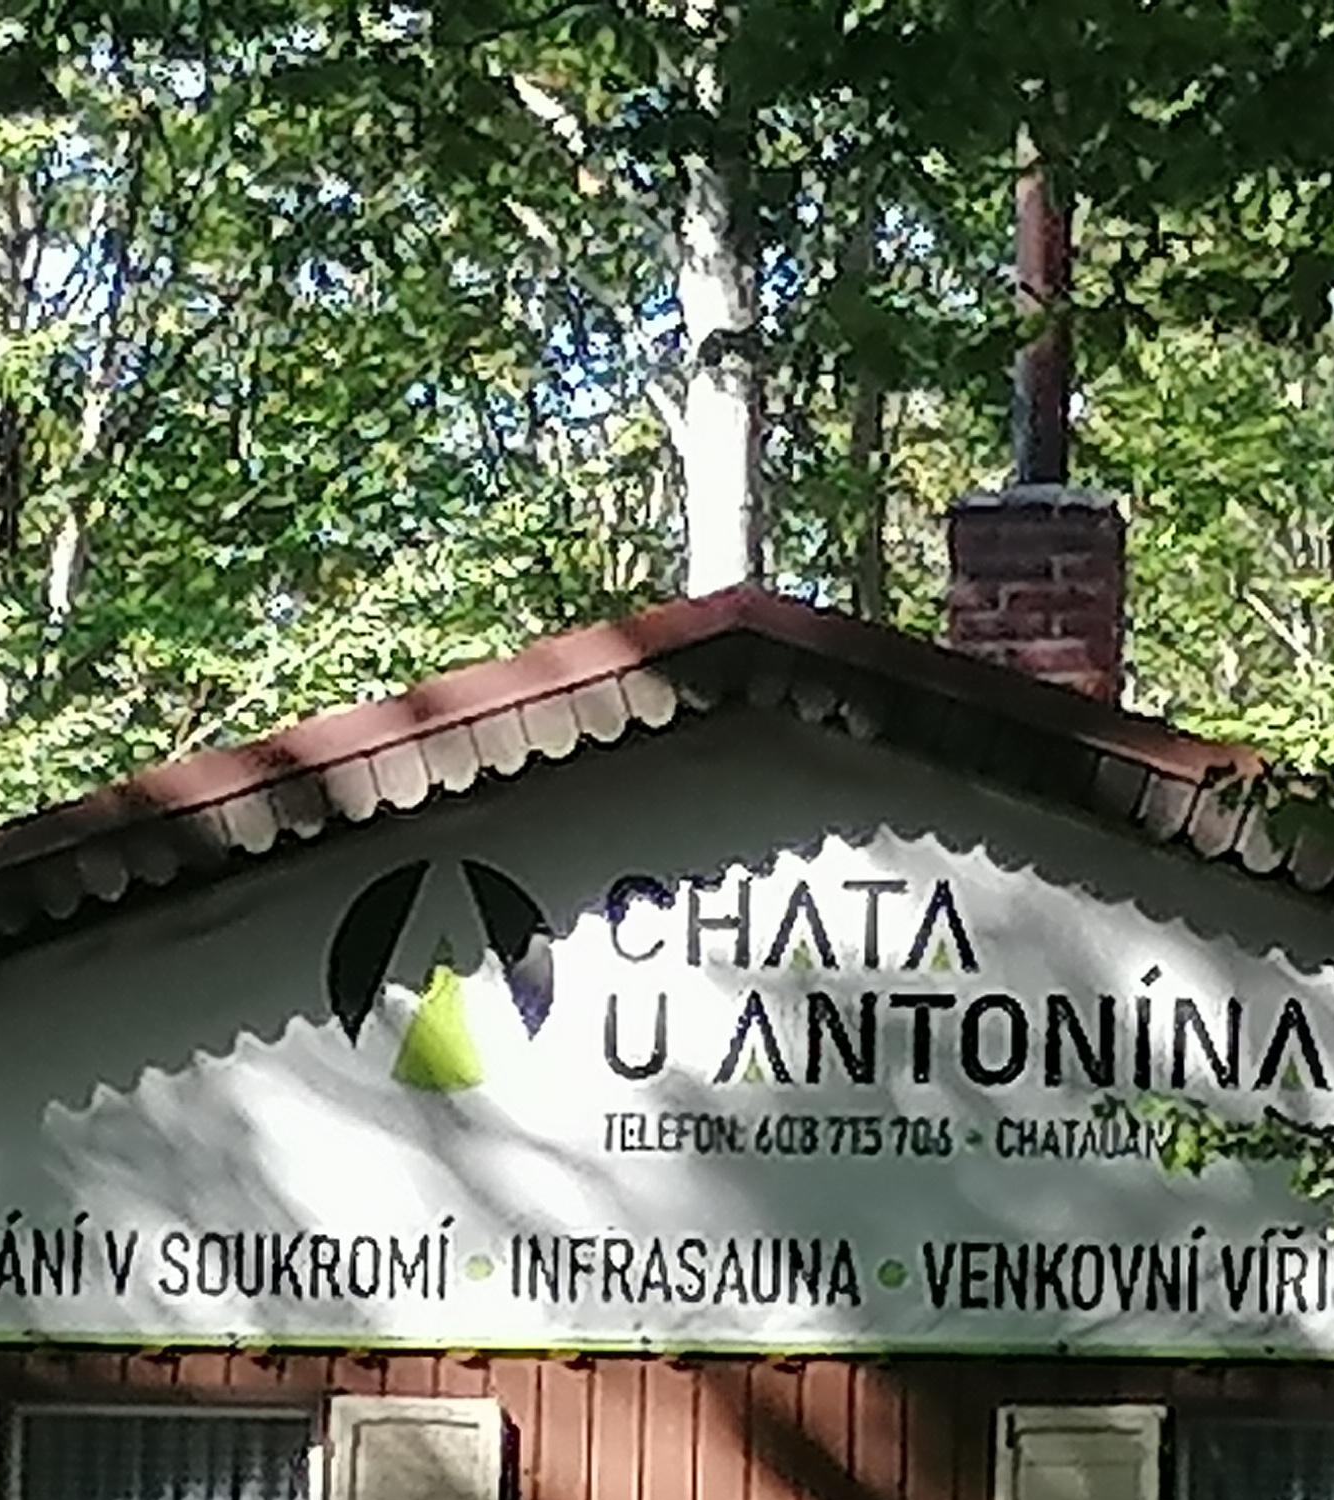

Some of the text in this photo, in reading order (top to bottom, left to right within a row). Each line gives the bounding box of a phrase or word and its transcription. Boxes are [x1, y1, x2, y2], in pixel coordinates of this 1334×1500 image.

[604, 876, 980, 974] CHATA
[603, 966, 1334, 1092] U ANTONÍNA
[104, 1230, 140, 1297] V
[157, 1215, 456, 1302] SOUKROMÍ
[510, 1232, 863, 1307] INFRASAUNA
[921, 1225, 1207, 1315] VENKOVNÍ
